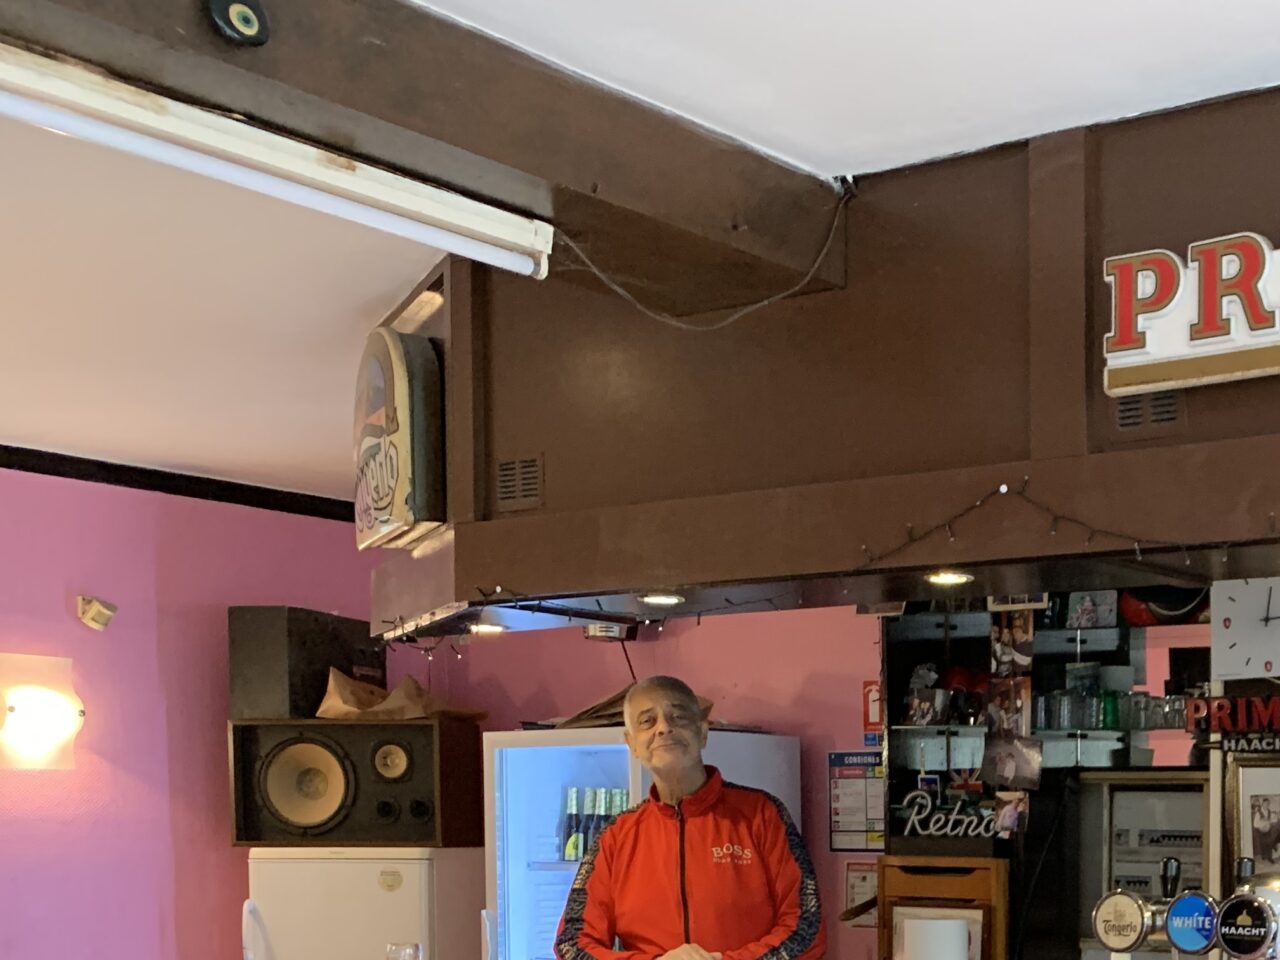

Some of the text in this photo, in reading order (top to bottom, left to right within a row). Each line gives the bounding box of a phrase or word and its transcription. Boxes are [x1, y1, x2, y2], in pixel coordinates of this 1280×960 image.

[903, 791, 997, 837] Retro
[711, 842, 753, 859] BOSS
[1221, 925, 1267, 936] HAACHT
